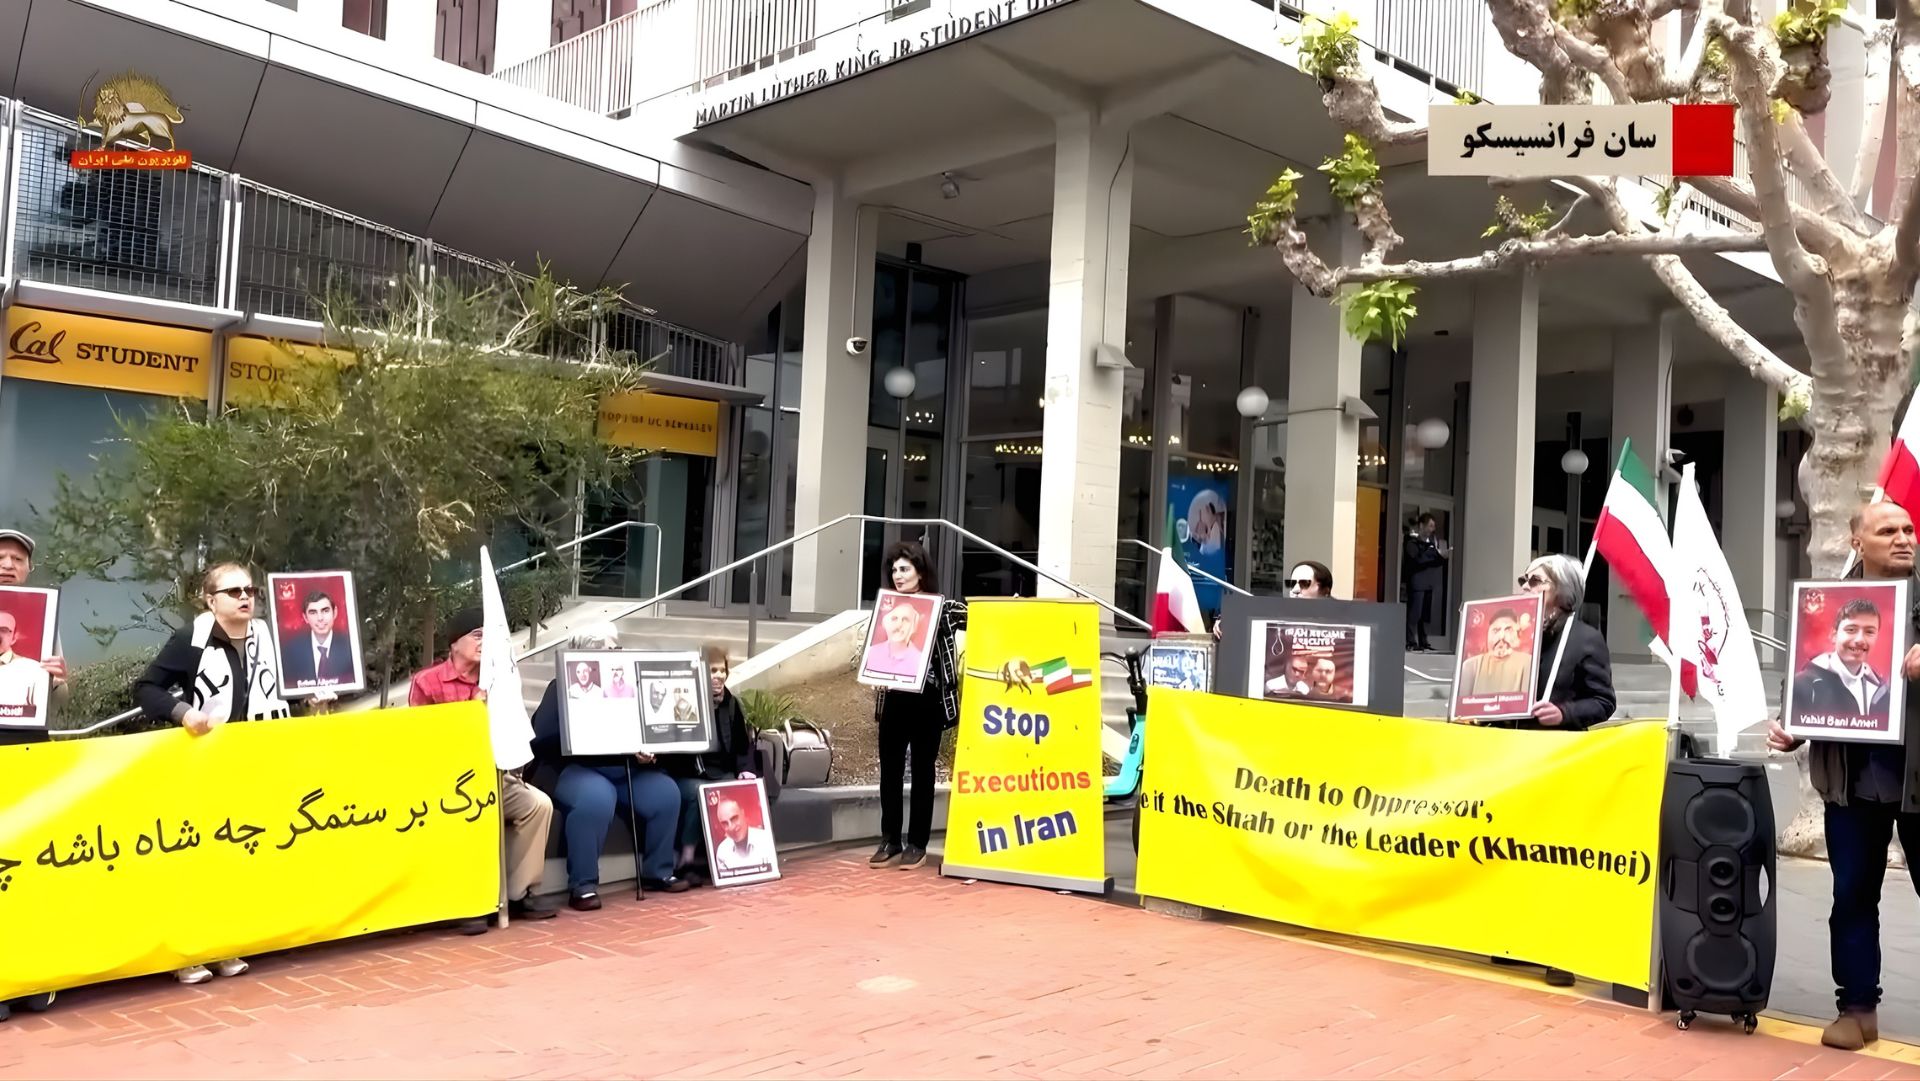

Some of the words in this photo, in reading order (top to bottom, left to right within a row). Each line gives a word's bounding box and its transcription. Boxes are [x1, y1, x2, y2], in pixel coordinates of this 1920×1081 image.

[695, 91, 754, 126] MARTIN
[762, 65, 830, 102] LUTHER
[836, 49, 881, 78] KING
[919, 0, 1016, 49] STUDENT
[7, 321, 67, 364] Cal
[76, 342, 199, 373] STUDENT
[230, 361, 286, 384] STOR
[983, 704, 1050, 744] Stop
[440, 769, 496, 823] مرگ
[957, 766, 1092, 794] Executions
[1234, 767, 1312, 801] Death
[1318, 782, 1344, 807] to
[1353, 785, 1493, 823] Oppressor,
[135, 817, 201, 856] شاه
[214, 817, 266, 855] چه
[276, 787, 387, 850] ستمگر
[395, 800, 428, 833] بر
[977, 820, 1008, 855] in
[1014, 810, 1077, 847] Iran
[1140, 792, 1149, 809] e
[1153, 790, 1165, 813] it
[1173, 794, 1208, 819] the
[1212, 801, 1274, 835] Shah
[1283, 820, 1313, 840] or
[1321, 822, 1358, 849] the
[1366, 826, 1460, 859] Leader
[1469, 836, 1651, 886] (Khamenei)
[36, 824, 120, 872] باشه
